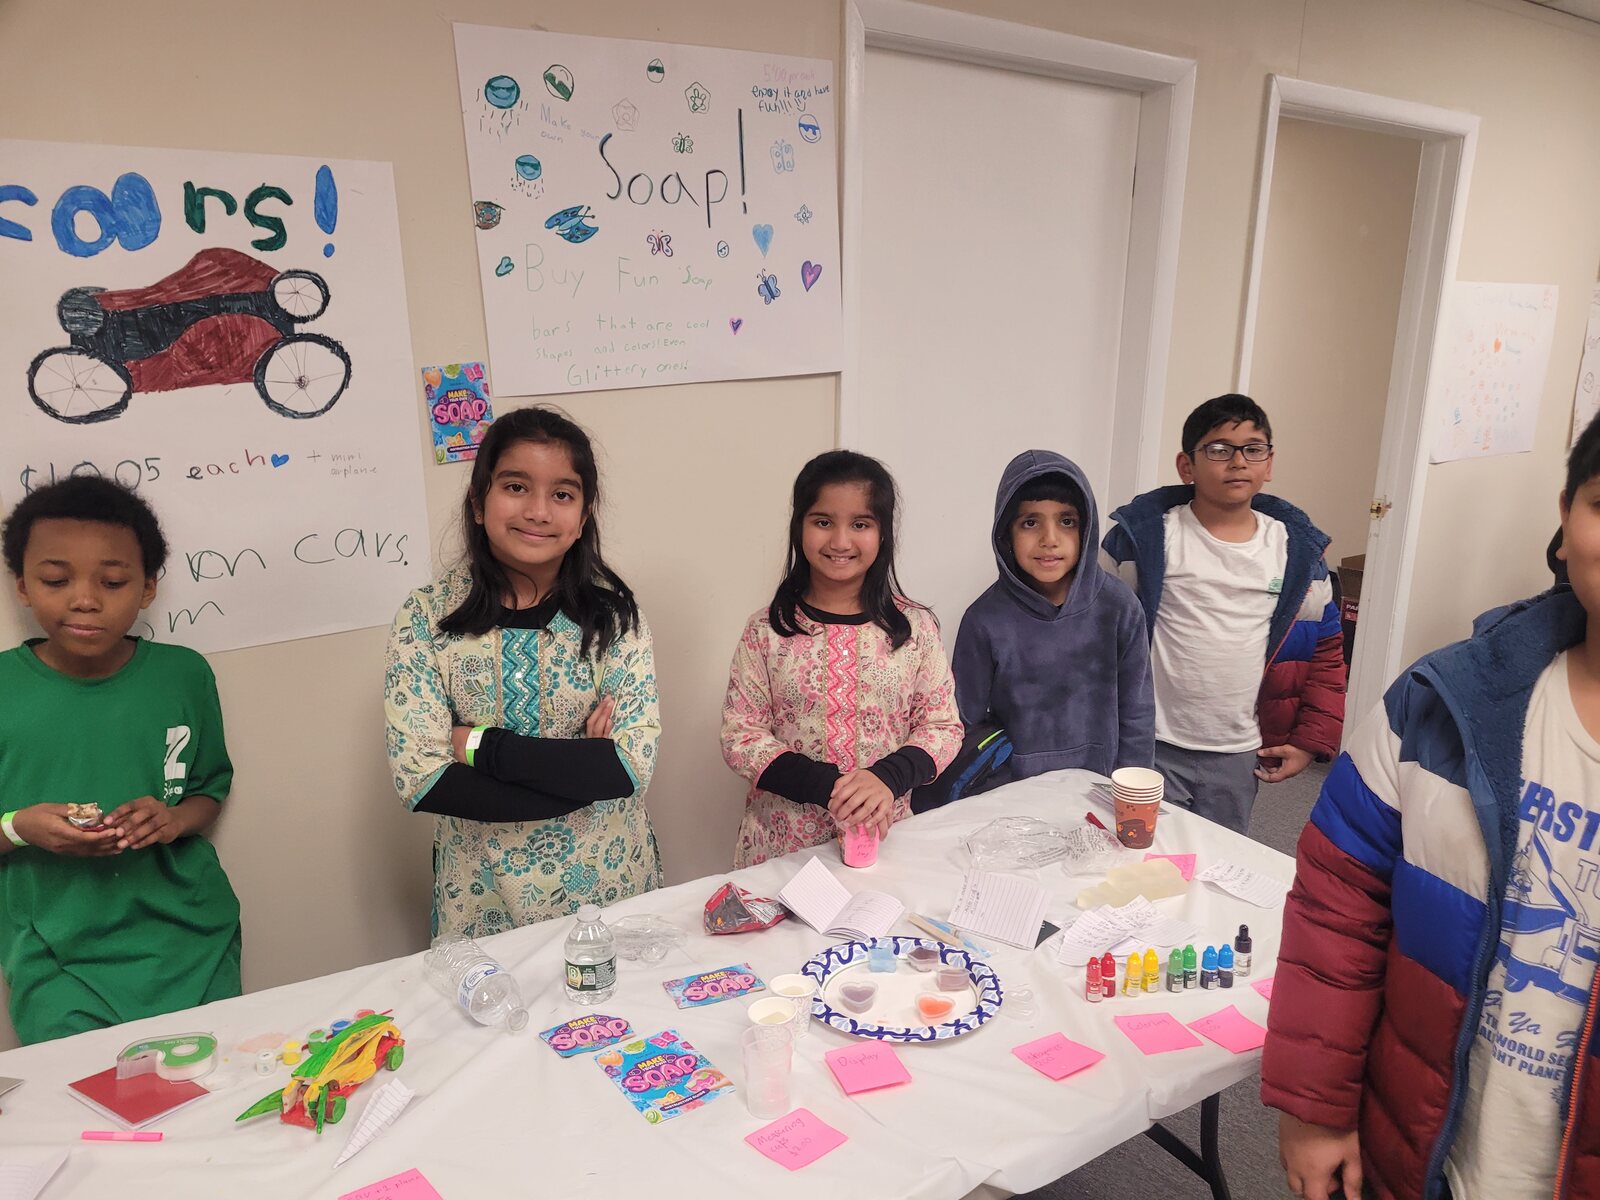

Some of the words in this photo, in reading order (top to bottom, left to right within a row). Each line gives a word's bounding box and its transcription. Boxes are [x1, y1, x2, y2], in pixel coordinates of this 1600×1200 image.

[783, 86, 792, 98] it
[794, 89, 812, 100] and
[814, 84, 830, 95] have
[540, 103, 571, 130] Make
[540, 130, 564, 143] own
[599, 107, 749, 229] Soap!
[525, 243, 585, 299] Buy
[617, 255, 660, 295] Fun
[681, 264, 713, 291] Soap
[532, 313, 572, 342] bars
[596, 313, 637, 331] that
[646, 320, 673, 331] are
[686, 319, 710, 330] cool
[593, 341, 616, 355] and
[447, 390, 468, 399] MAKE
[434, 399, 487, 424] SOAP
[186, 448, 267, 480] each
[684, 973, 755, 1001] SOAP
[701, 971, 727, 981] MAKE
[551, 1019, 628, 1050] SOAP
[568, 1016, 596, 1028] MAKE
[836, 1052, 879, 1067] Display
[1496, 1033, 1546, 1061] WORLD
[625, 1055, 697, 1092] SOAP
[637, 1055, 664, 1069] MAKE
